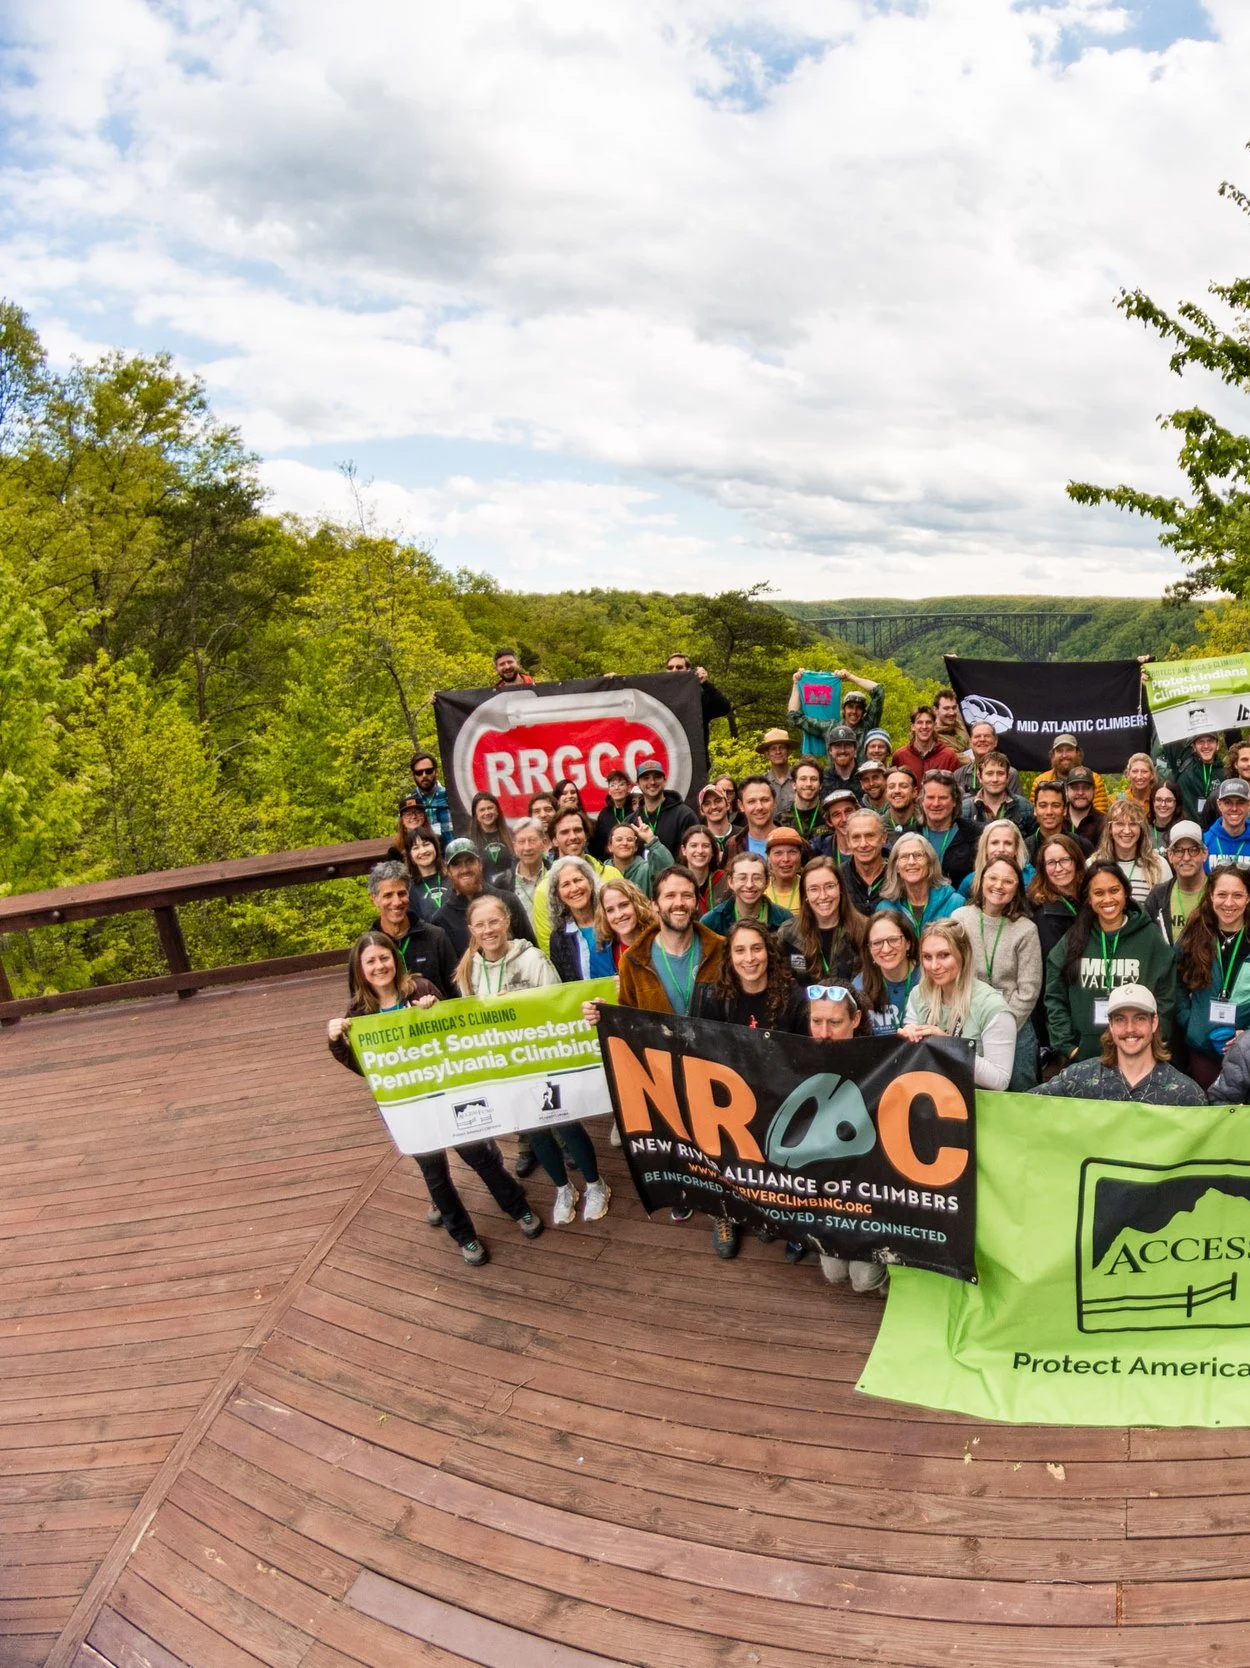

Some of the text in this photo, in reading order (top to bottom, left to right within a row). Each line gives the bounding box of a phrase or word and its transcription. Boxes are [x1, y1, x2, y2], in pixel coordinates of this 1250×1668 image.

[1151, 667, 1248, 691] Protect Indiana
[1153, 683, 1211, 703] Climbing
[1017, 720, 1039, 733] MID
[1041, 718, 1094, 733] ATLANTIC
[484, 739, 656, 798] RRGCC
[1080, 957, 1140, 976] MUIR
[358, 1008, 517, 1047] PROTECT AMERICA'S CLIMBING
[362, 1017, 591, 1070] Protect Southwestern
[368, 1036, 602, 1092] Pennsylvania Climbing
[631, 1138, 672, 1153] NEW
[724, 1166, 818, 1194] ALLIANCE
[823, 1180, 852, 1195] OF
[858, 1182, 960, 1212] CLIMBERS
[643, 1171, 662, 1183] BE
[663, 1170, 724, 1193] INFORMED
[826, 1215, 858, 1231] STAY
[860, 1221, 947, 1243] CONNECTED
[1012, 1351, 1121, 1374] Protect
